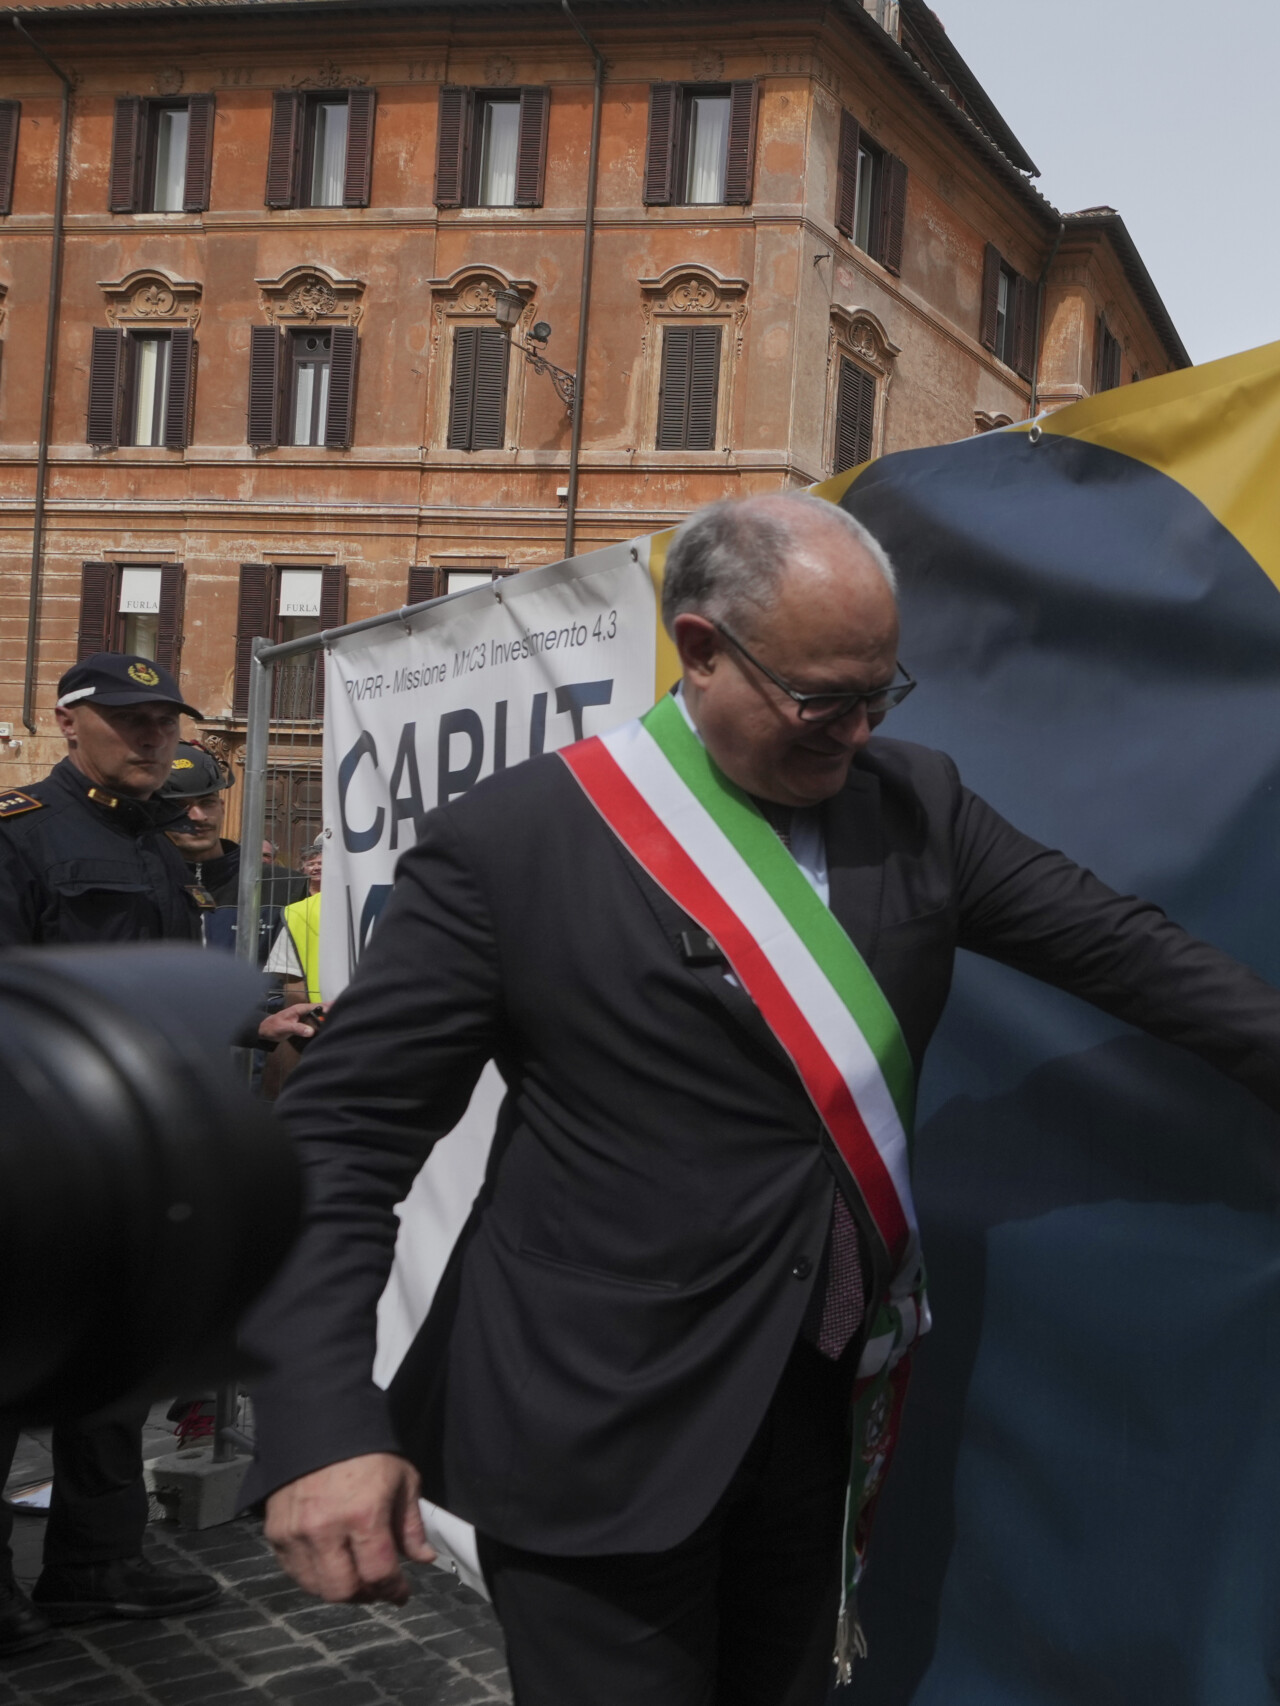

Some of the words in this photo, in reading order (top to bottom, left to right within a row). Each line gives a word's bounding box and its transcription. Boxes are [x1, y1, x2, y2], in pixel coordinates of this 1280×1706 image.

[127, 600, 159, 609] FURLA
[286, 603, 318, 612] FURLA
[346, 675, 383, 702] PNRR
[393, 663, 447, 694] Missione
[452, 643, 486, 679] M1C3
[592, 610, 617, 642] 4.3
